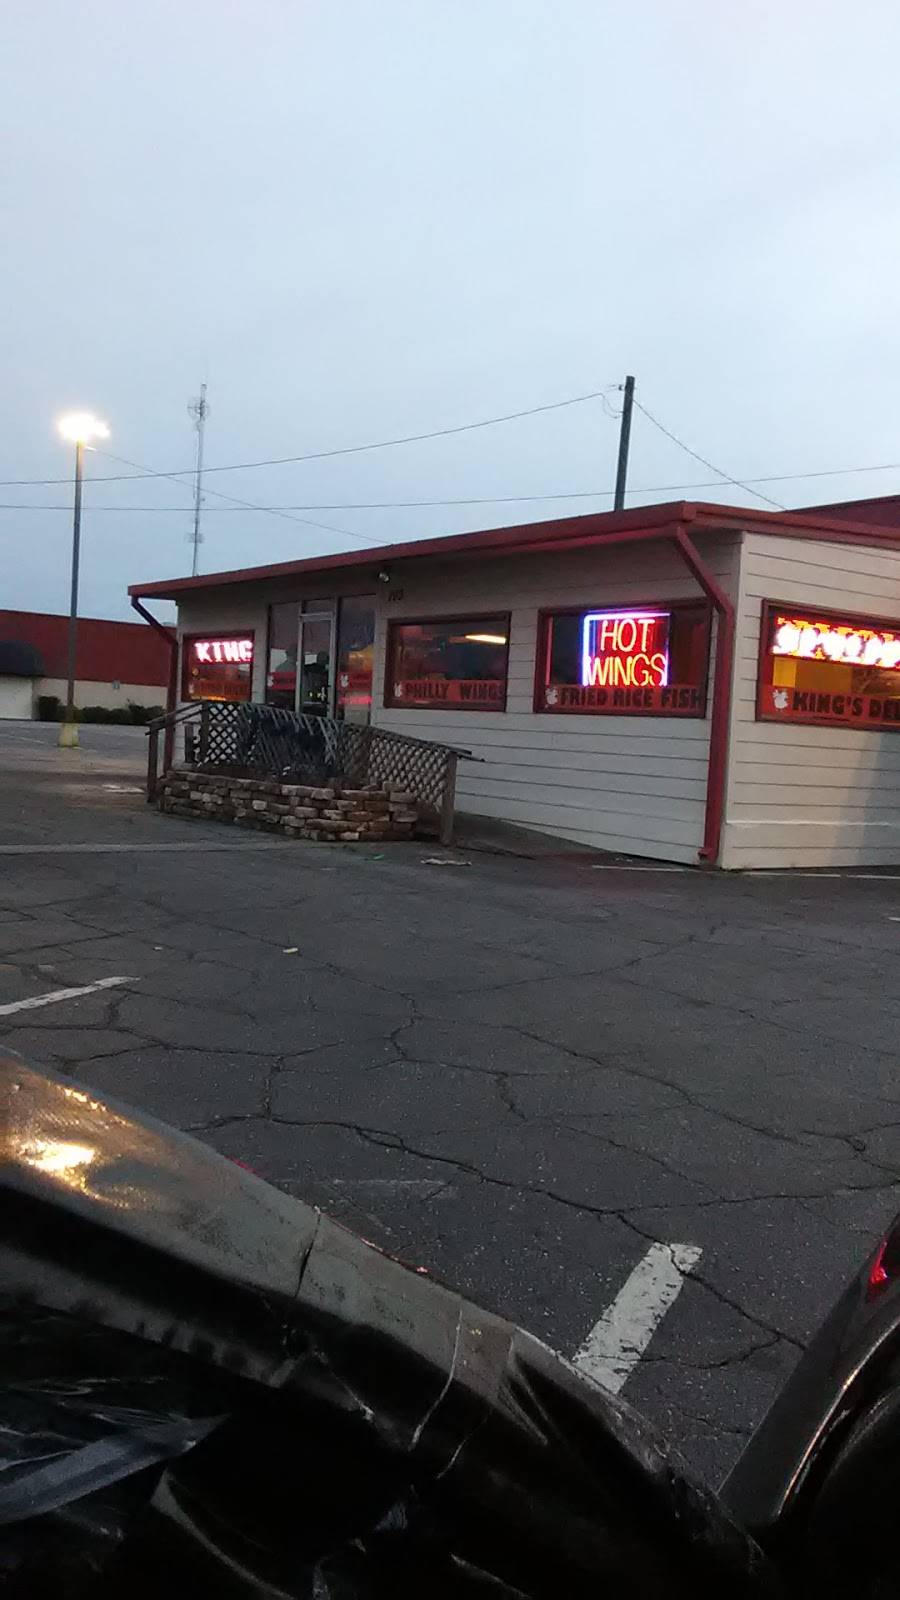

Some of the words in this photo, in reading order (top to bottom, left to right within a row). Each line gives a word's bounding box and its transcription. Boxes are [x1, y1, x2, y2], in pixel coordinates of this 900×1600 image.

[600, 618, 655, 652] HOT
[584, 653, 667, 686] WINGS
[405, 682, 450, 699] PHILLY
[560, 687, 609, 706] FRIED
[613, 687, 655, 707] RICE
[661, 687, 700, 708] FISH
[792, 691, 863, 717] KING'S
